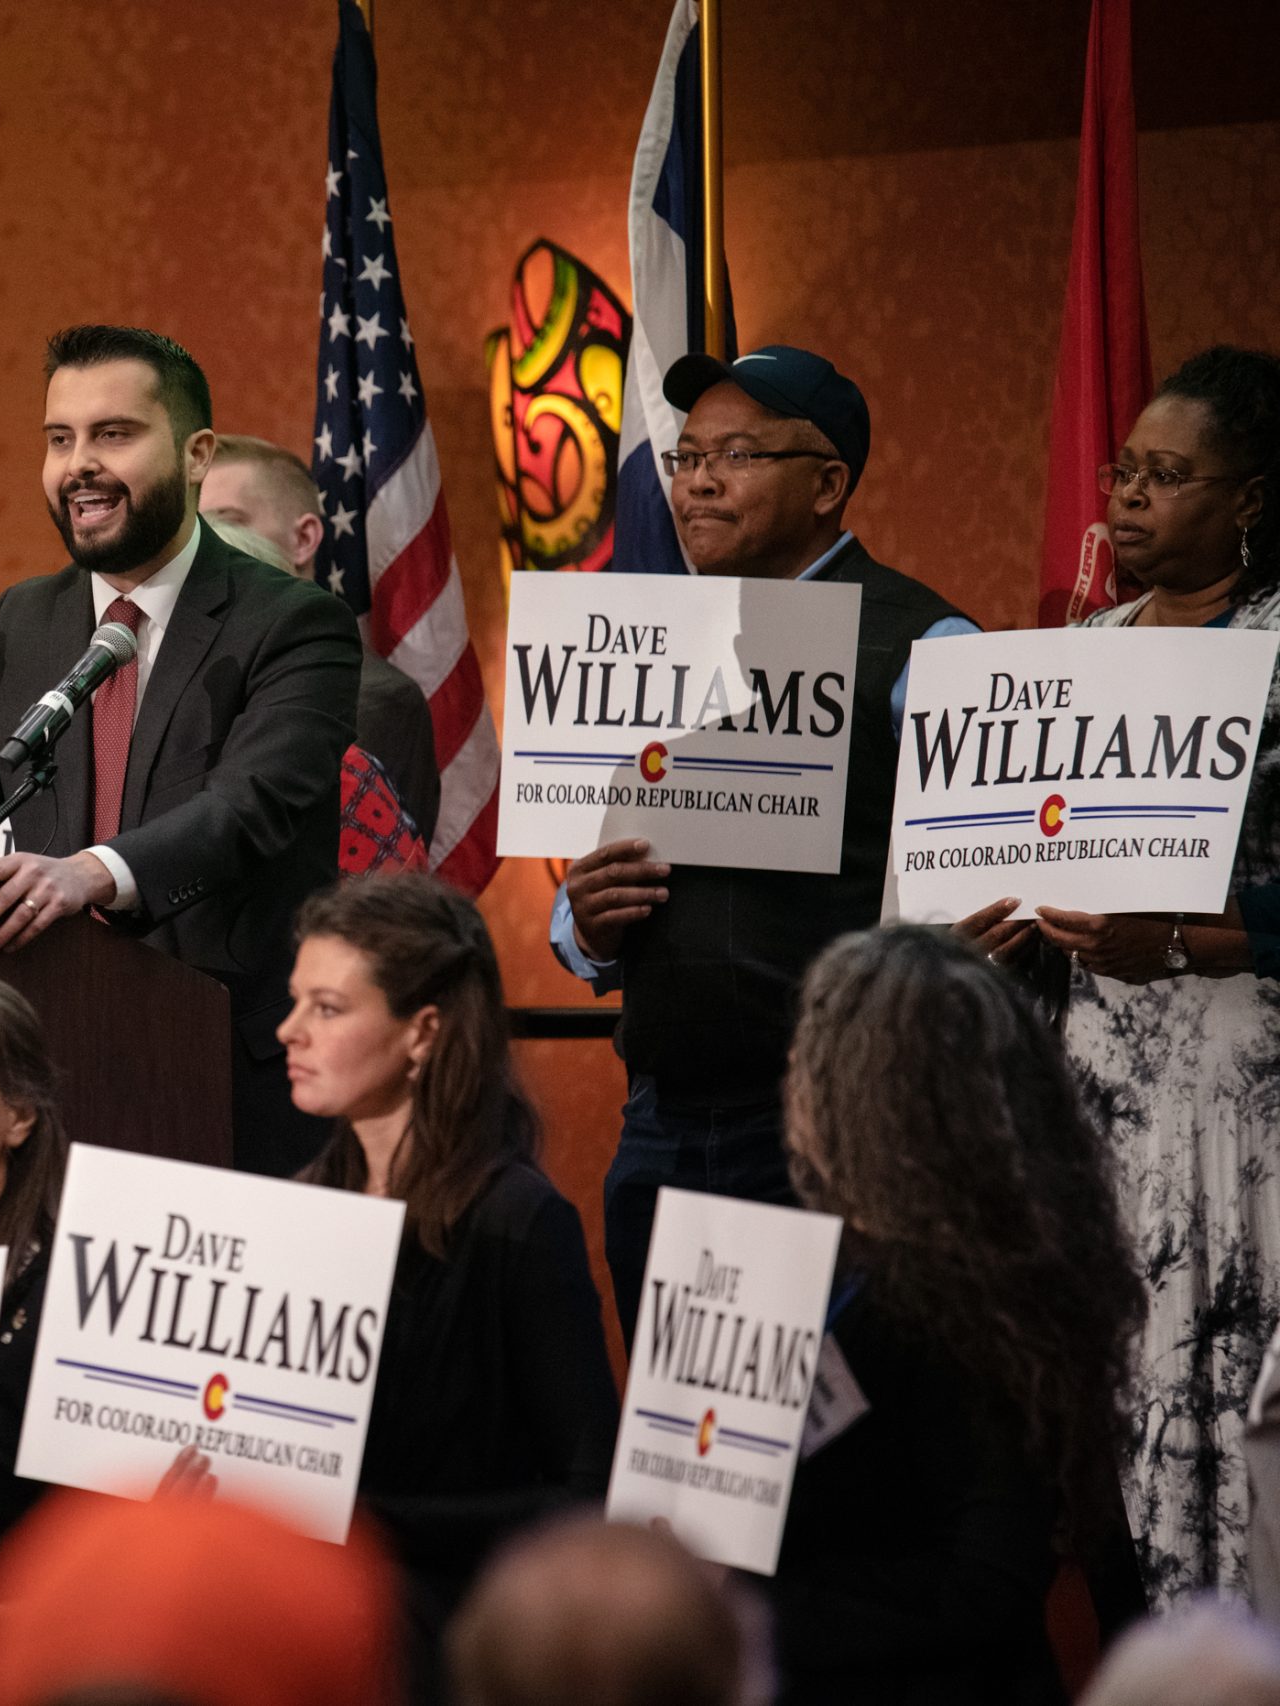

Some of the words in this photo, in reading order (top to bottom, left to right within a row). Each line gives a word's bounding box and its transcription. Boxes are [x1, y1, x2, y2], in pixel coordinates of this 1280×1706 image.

[585, 614, 668, 656] DAVE
[512, 643, 845, 739] WILLIAMS
[986, 672, 1073, 714] DAVE
[910, 706, 1251, 793] WILLIAMS
[516, 783, 544, 804] FOR
[546, 784, 632, 808] COLORADO
[635, 787, 754, 814] REPUBLICAN
[757, 792, 820, 818] CHAIR
[905, 850, 935, 873] FOR
[938, 844, 1031, 870] COLORADO
[1035, 838, 1144, 864] REPUBLICAN
[1147, 837, 1210, 859] CHAIR
[160, 1212, 246, 1272] DAVE
[695, 1249, 742, 1304] DAVE
[67, 1232, 378, 1385] WILLIAMS
[649, 1280, 815, 1410] WILLIAMS
[55, 1396, 91, 1428] FOR
[95, 1404, 191, 1445] COLORADO
[194, 1424, 294, 1468] REPUBLICAN
[297, 1449, 342, 1479] CHAIR
